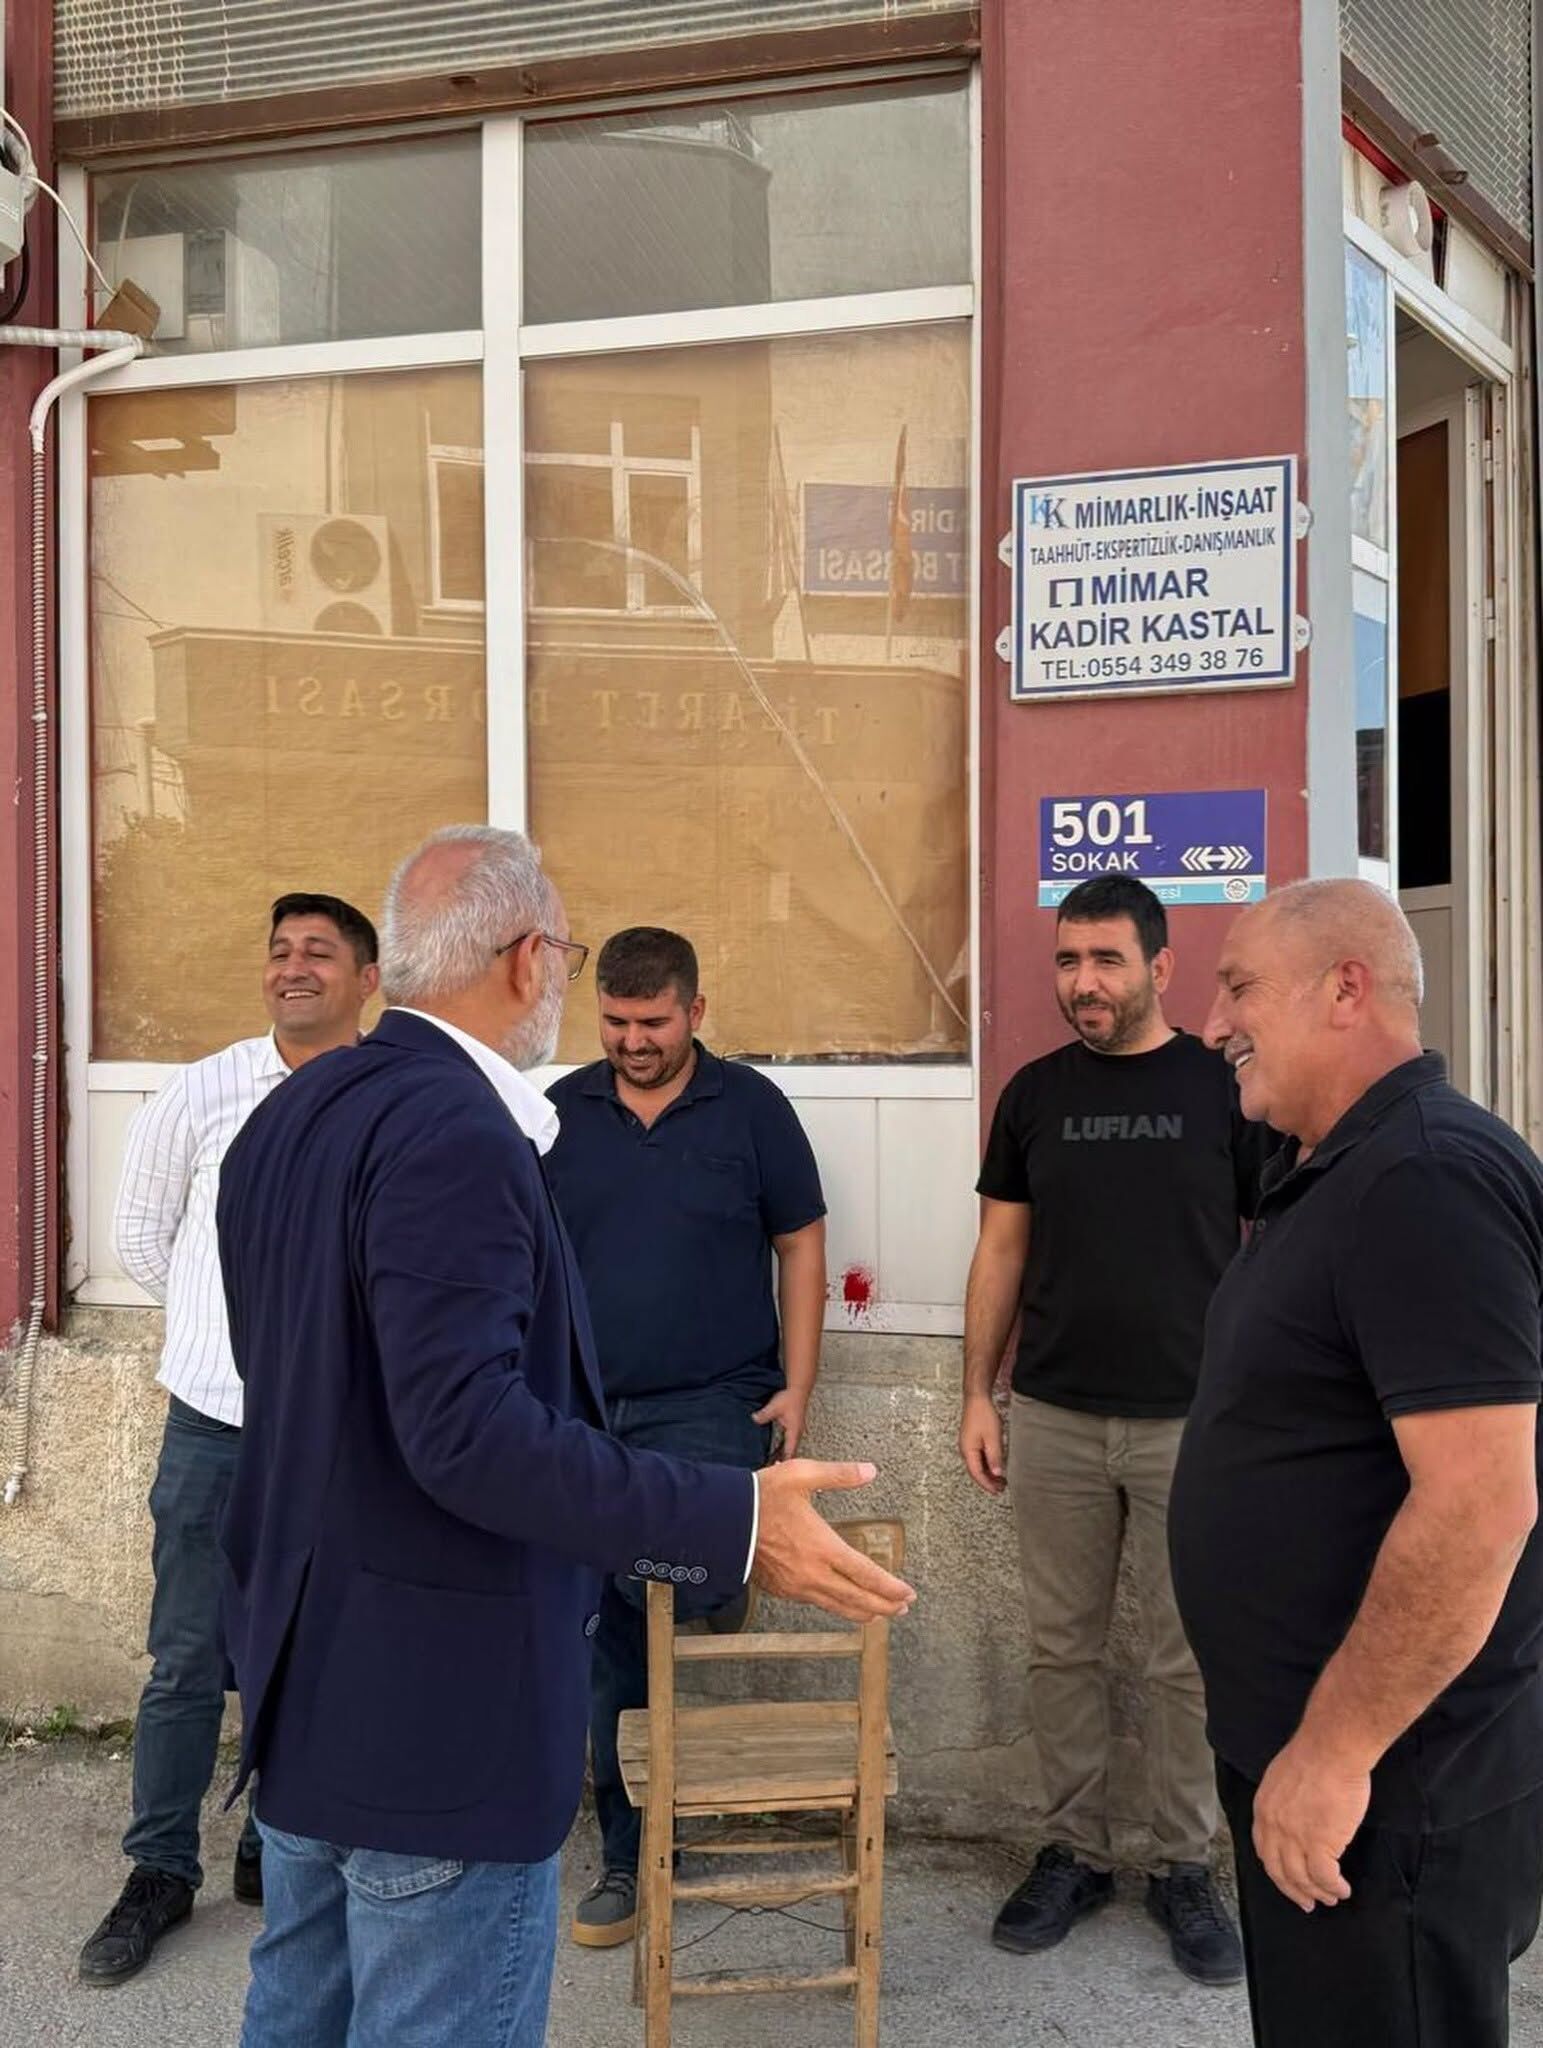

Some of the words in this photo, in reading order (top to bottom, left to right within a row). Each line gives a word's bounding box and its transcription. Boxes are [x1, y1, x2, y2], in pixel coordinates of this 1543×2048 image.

[1075, 485, 1278, 529] MİMARLIK-İNŞAAT
[1091, 567, 1210, 605] MİMAR
[1030, 612, 1131, 651] KADİR
[1142, 607, 1275, 643] KASTAL
[1041, 655, 1143, 680] TEL:0554
[1150, 652, 1191, 674] 349
[1199, 650, 1227, 671] 38
[1236, 647, 1264, 667] 76
[1052, 800, 1153, 847] 501
[1052, 851, 1140, 873] SOKAK
[1062, 1114, 1184, 1141] LUFIAN
